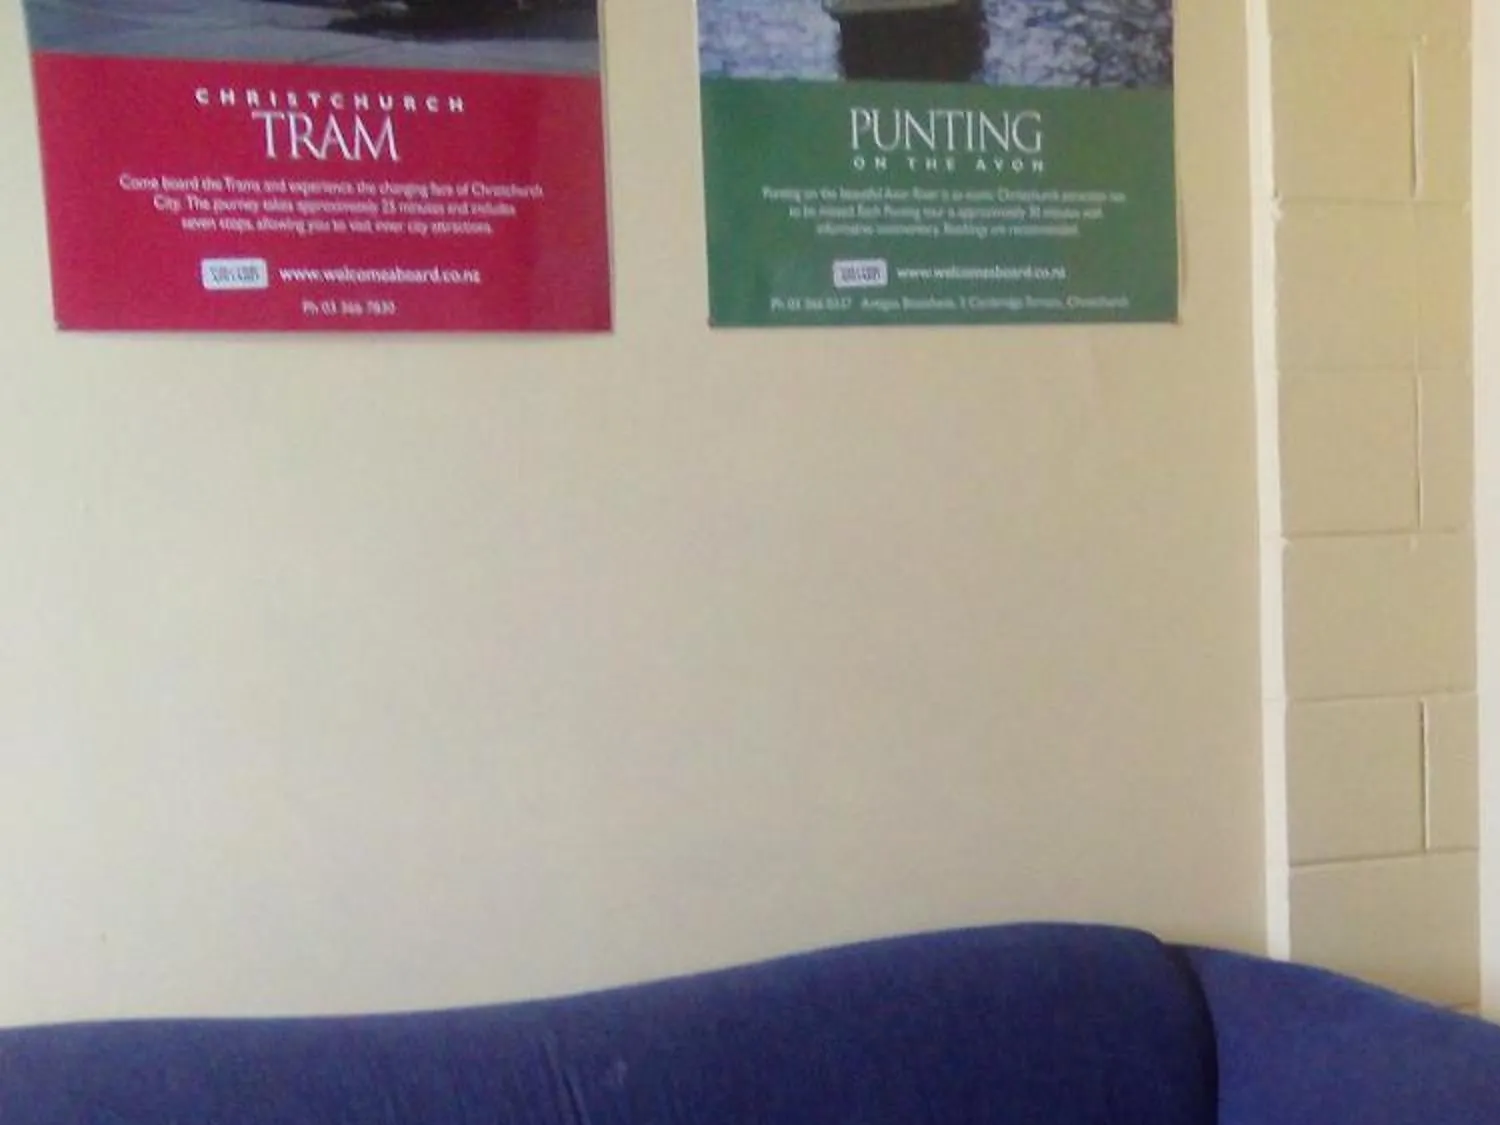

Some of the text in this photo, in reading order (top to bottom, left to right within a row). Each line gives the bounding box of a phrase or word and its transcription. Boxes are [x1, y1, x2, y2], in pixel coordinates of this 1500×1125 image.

[195, 87, 465, 112] CHRISTCHURCH
[252, 109, 401, 161] TRAM
[850, 106, 1042, 153] PUNTING
[853, 155, 1044, 173] ON THE AVON
[119, 173, 159, 190] Come
[201, 177, 222, 191] the
[224, 176, 260, 193] Trams
[263, 179, 286, 193] and
[356, 181, 376, 195] the
[379, 181, 429, 198] changing
[456, 183, 470, 196] of
[471, 183, 544, 197] Christchurch
[187, 195, 210, 210] The
[213, 197, 259, 213] journey
[399, 201, 444, 215] minutes
[447, 202, 469, 215] and
[279, 264, 480, 284] www.welcomeaboard.co.nz
